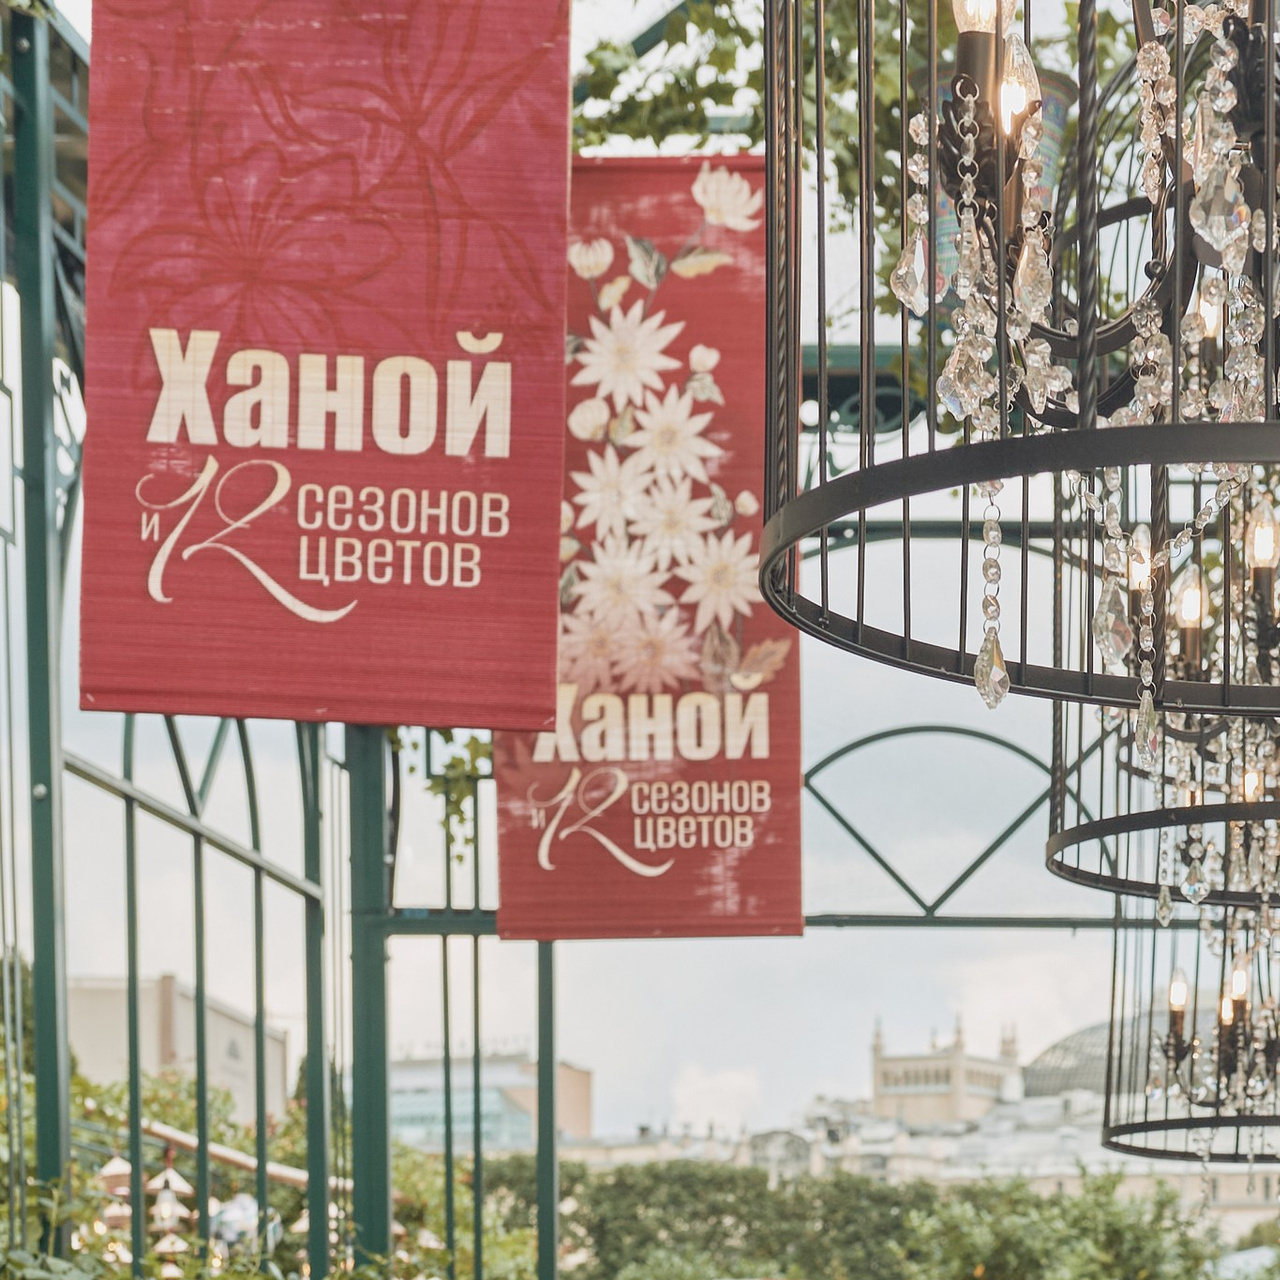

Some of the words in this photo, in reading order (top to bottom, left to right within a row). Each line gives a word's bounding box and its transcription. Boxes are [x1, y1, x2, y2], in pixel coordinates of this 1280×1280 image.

[146, 328, 512, 458] Ханой
[136, 454, 358, 622] 12
[140, 511, 160, 542] и
[297, 484, 510, 537] сезонов
[299, 536, 481, 587] цветов
[533, 672, 770, 762] Ханой
[527, 767, 675, 877] 12
[631, 780, 771, 815] сезонов
[634, 815, 755, 852] цветов
